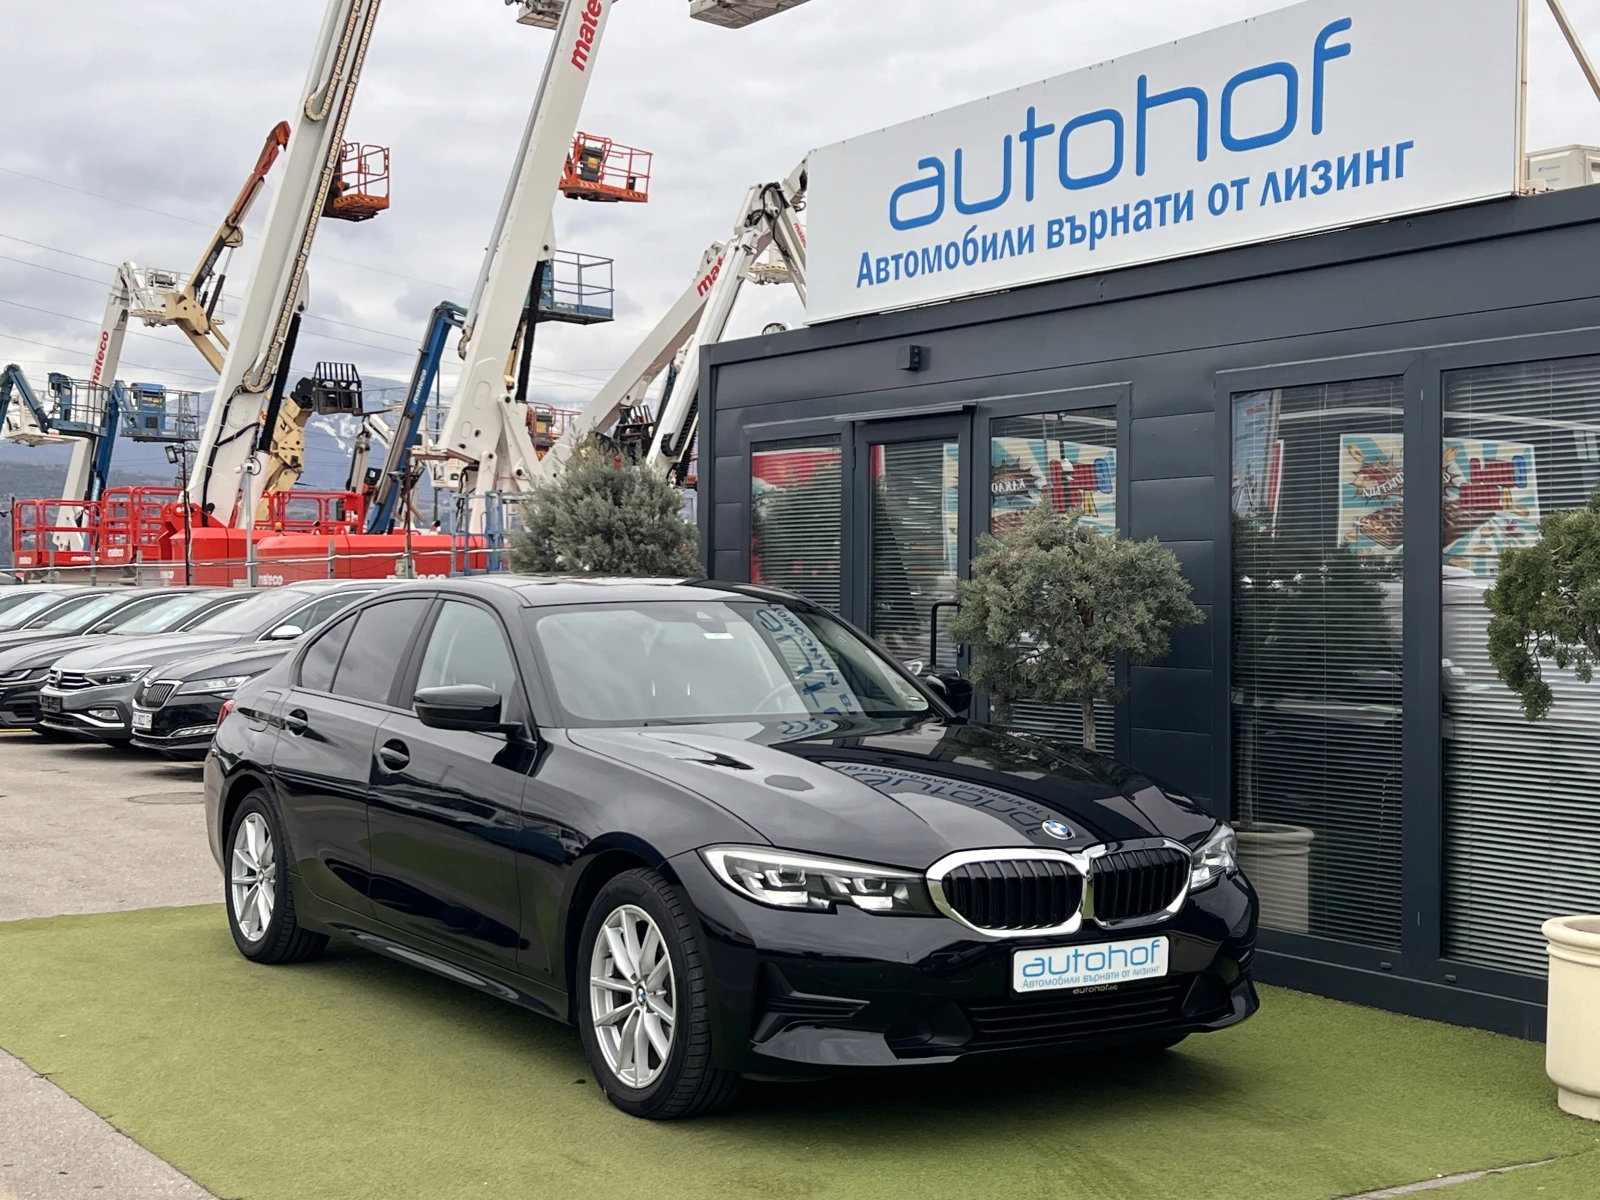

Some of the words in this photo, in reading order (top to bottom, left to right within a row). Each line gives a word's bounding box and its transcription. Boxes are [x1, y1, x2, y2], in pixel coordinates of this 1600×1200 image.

[889, 18, 1352, 231] autohof
[856, 215, 1035, 288] Автомобили
[1047, 190, 1193, 250] върнати
[1208, 177, 1250, 217] от
[1260, 141, 1414, 206] лизинг
[1022, 939, 1160, 977] autohof
[1023, 975, 1080, 988] Автомобили
[1083, 971, 1119, 983] върнати
[1122, 969, 1131, 978] от
[1133, 966, 1160, 976] лизинг
